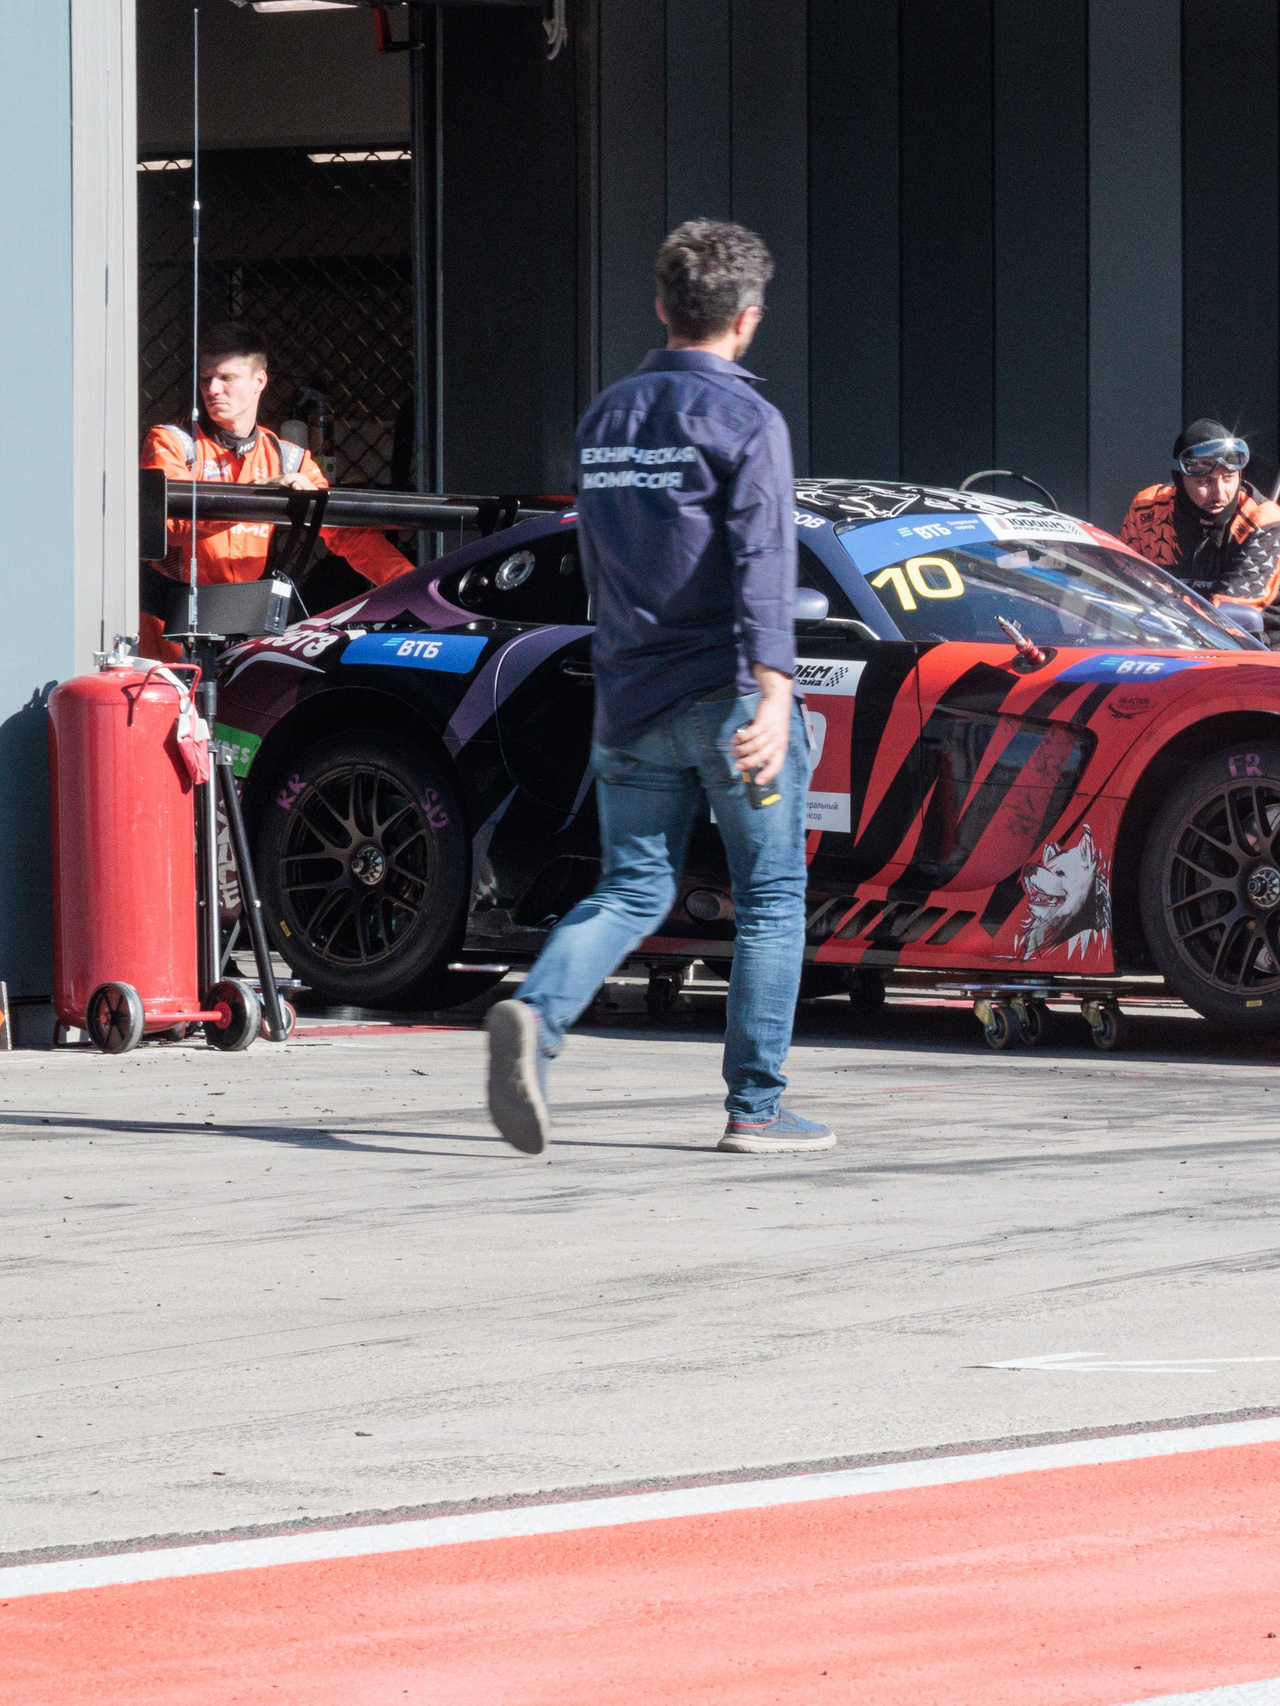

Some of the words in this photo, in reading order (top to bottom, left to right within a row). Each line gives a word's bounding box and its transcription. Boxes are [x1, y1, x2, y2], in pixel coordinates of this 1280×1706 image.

[912, 523, 952, 539] ВТБ
[871, 557, 964, 610] 10
[396, 640, 443, 659] ВТБ
[1115, 660, 1166, 675] ВТБ
